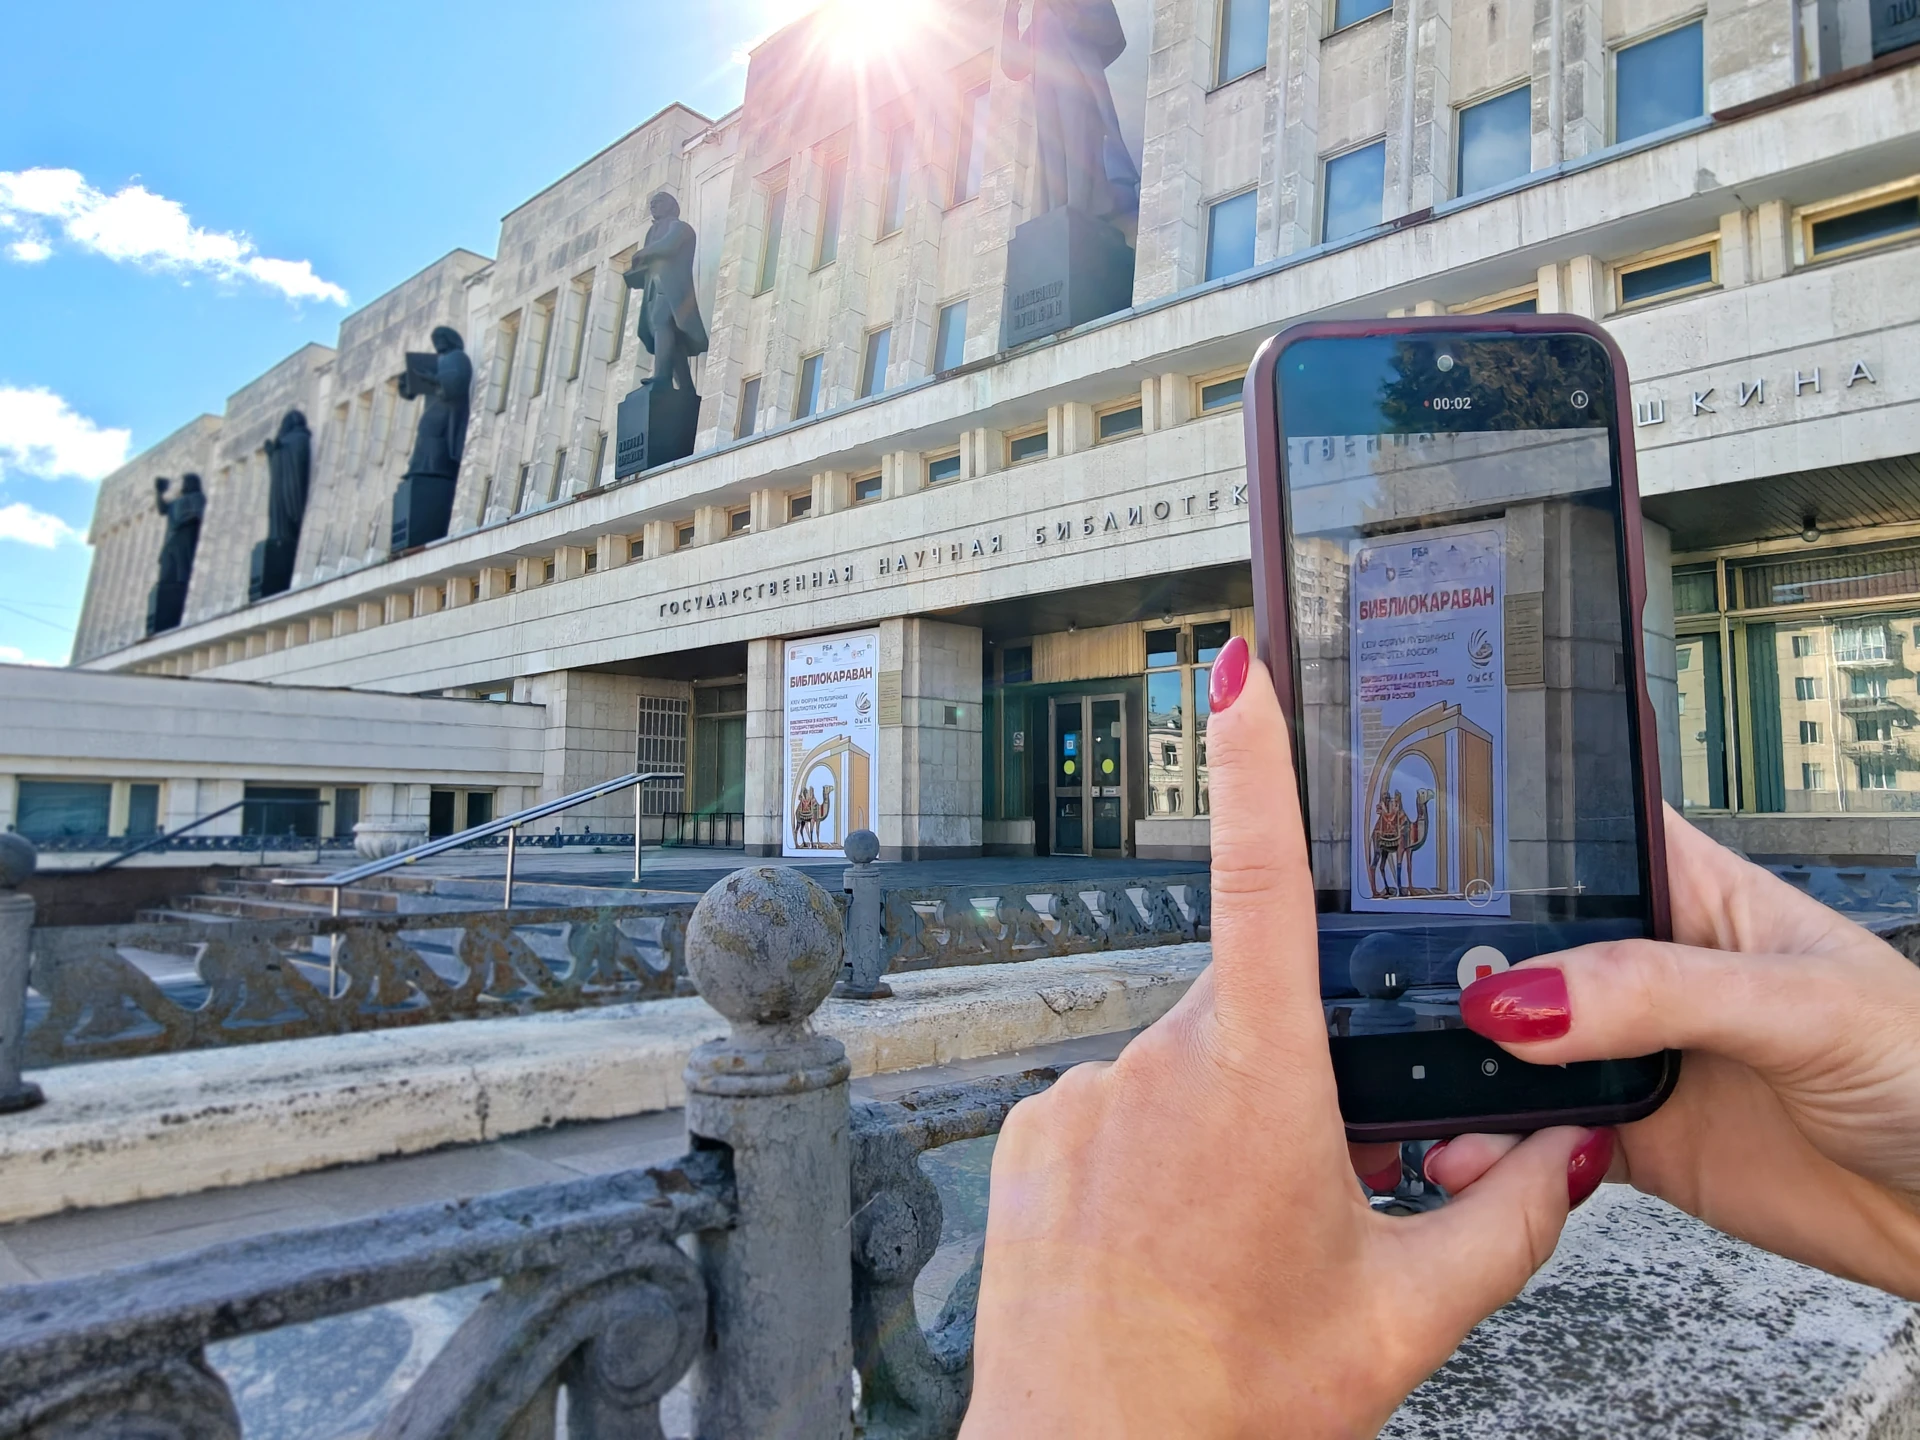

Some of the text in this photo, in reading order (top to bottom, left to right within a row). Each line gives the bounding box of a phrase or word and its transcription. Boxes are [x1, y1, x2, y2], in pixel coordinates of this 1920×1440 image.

[1433, 397, 1472, 411] 00:02
[659, 565, 854, 617] ГОСУДАРСТВЕННАЯ
[879, 534, 1003, 575] НАУЧНАЯ
[1034, 484, 1248, 545] БИБЛИОТЕК
[1359, 585, 1495, 620] БИБЛИОКАРАВАН
[790, 666, 873, 688] БИБЛИОКАРАВАН
